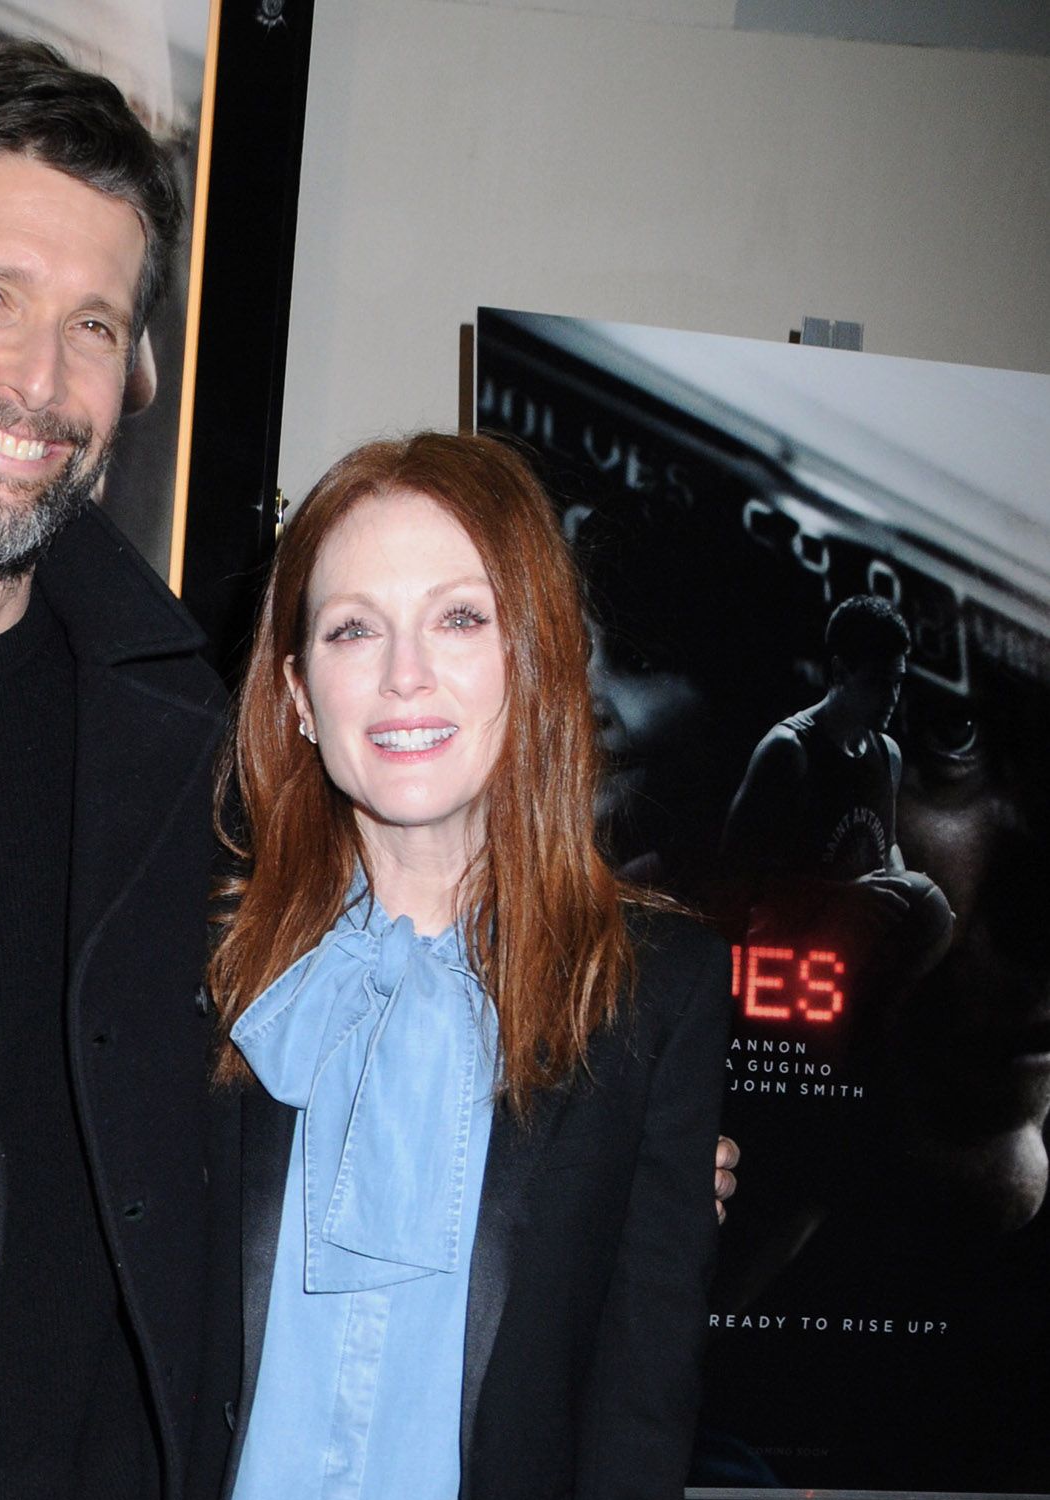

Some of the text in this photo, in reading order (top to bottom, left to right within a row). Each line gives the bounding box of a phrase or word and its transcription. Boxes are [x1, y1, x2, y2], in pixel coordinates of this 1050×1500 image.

[730, 1038, 806, 1054] ANNON
[747, 1059, 832, 1076] GUGINO
[730, 1079, 864, 1098] JOHN SMITH
[709, 1314, 947, 1335] READY TO RISE UP?
